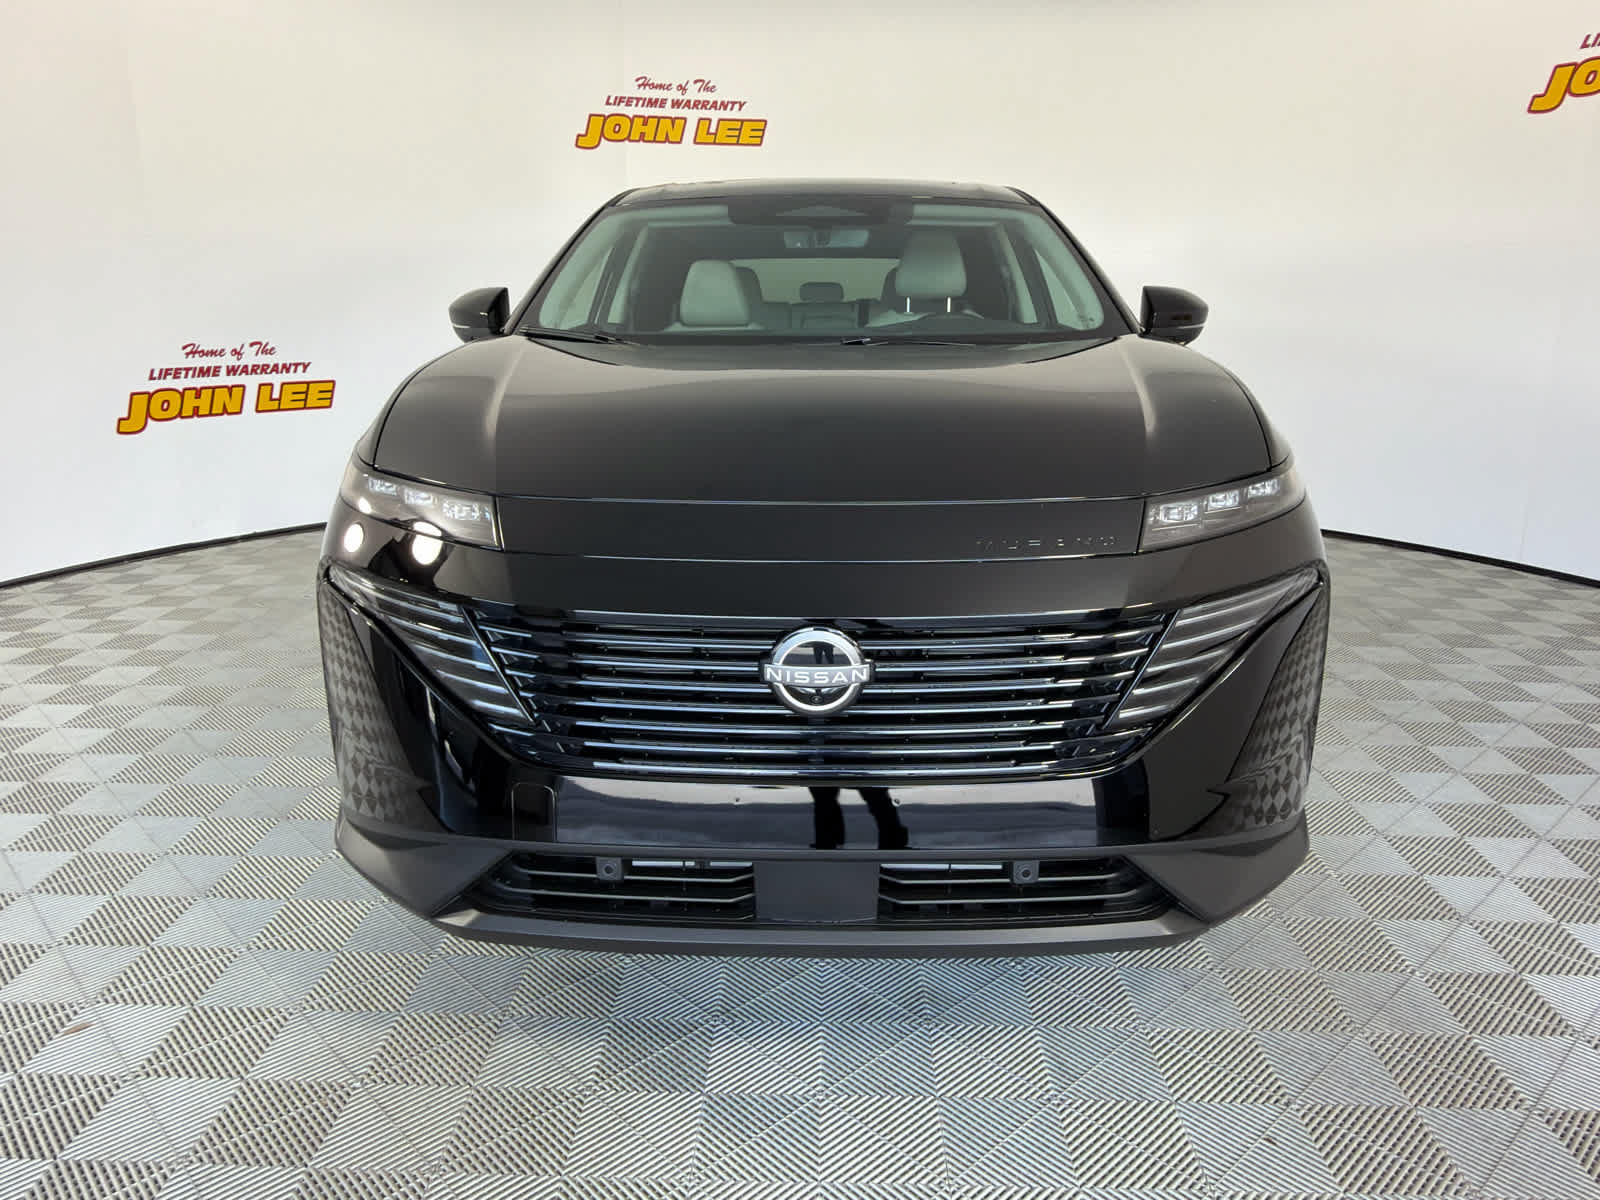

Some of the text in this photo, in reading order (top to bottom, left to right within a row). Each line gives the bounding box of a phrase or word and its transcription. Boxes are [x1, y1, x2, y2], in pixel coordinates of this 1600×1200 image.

[635, 76, 717, 96] Home of The
[605, 95, 747, 112] LIFETIME WARRANTY
[575, 113, 767, 149] JOHN LEE
[181, 341, 277, 361] Home of The
[148, 361, 312, 381] LIFETIME WARRANTY
[116, 380, 336, 435] JOHN LEE
[766, 667, 867, 684] NISSAN
